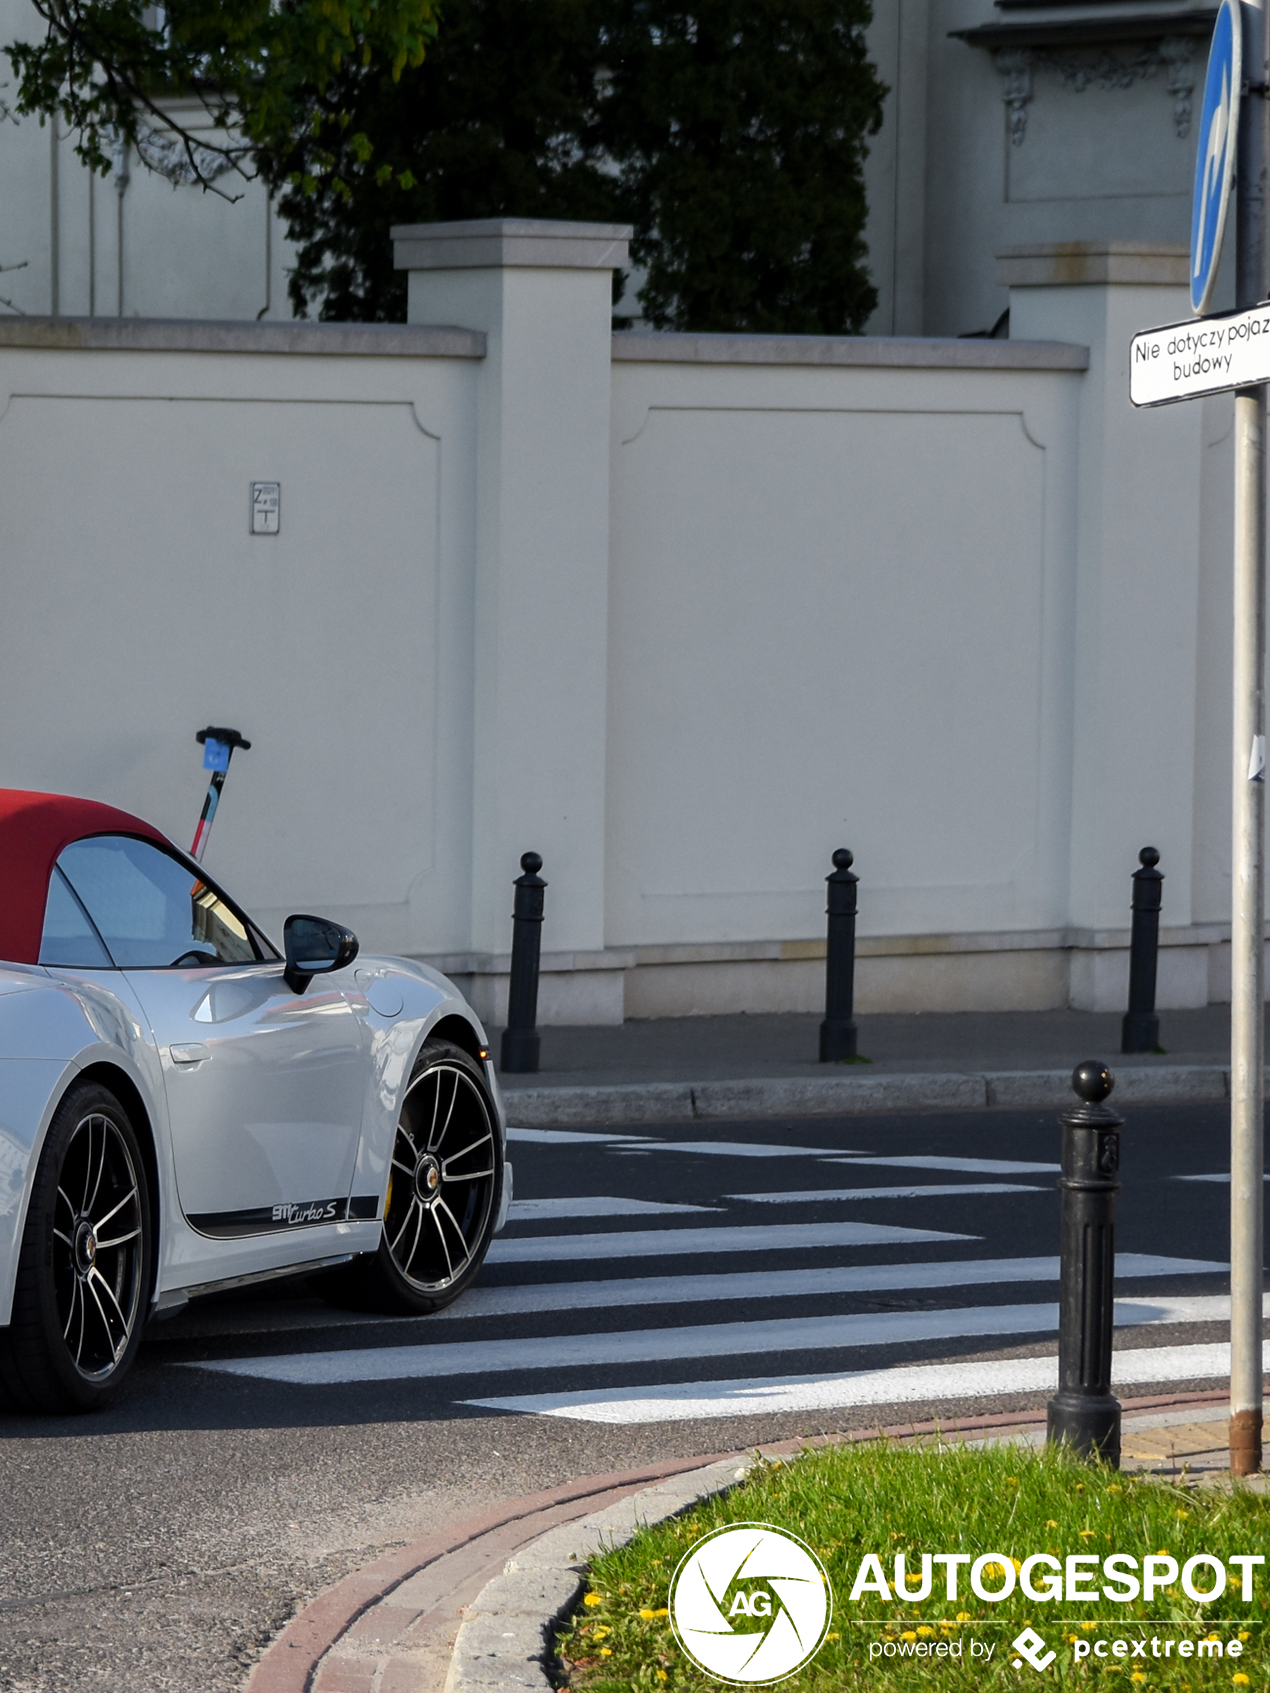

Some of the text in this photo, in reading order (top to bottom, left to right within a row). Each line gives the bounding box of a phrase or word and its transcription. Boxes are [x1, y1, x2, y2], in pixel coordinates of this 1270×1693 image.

[1135, 316, 1270, 363] Nie dotyczy pojaz
[1173, 353, 1233, 381] budowy
